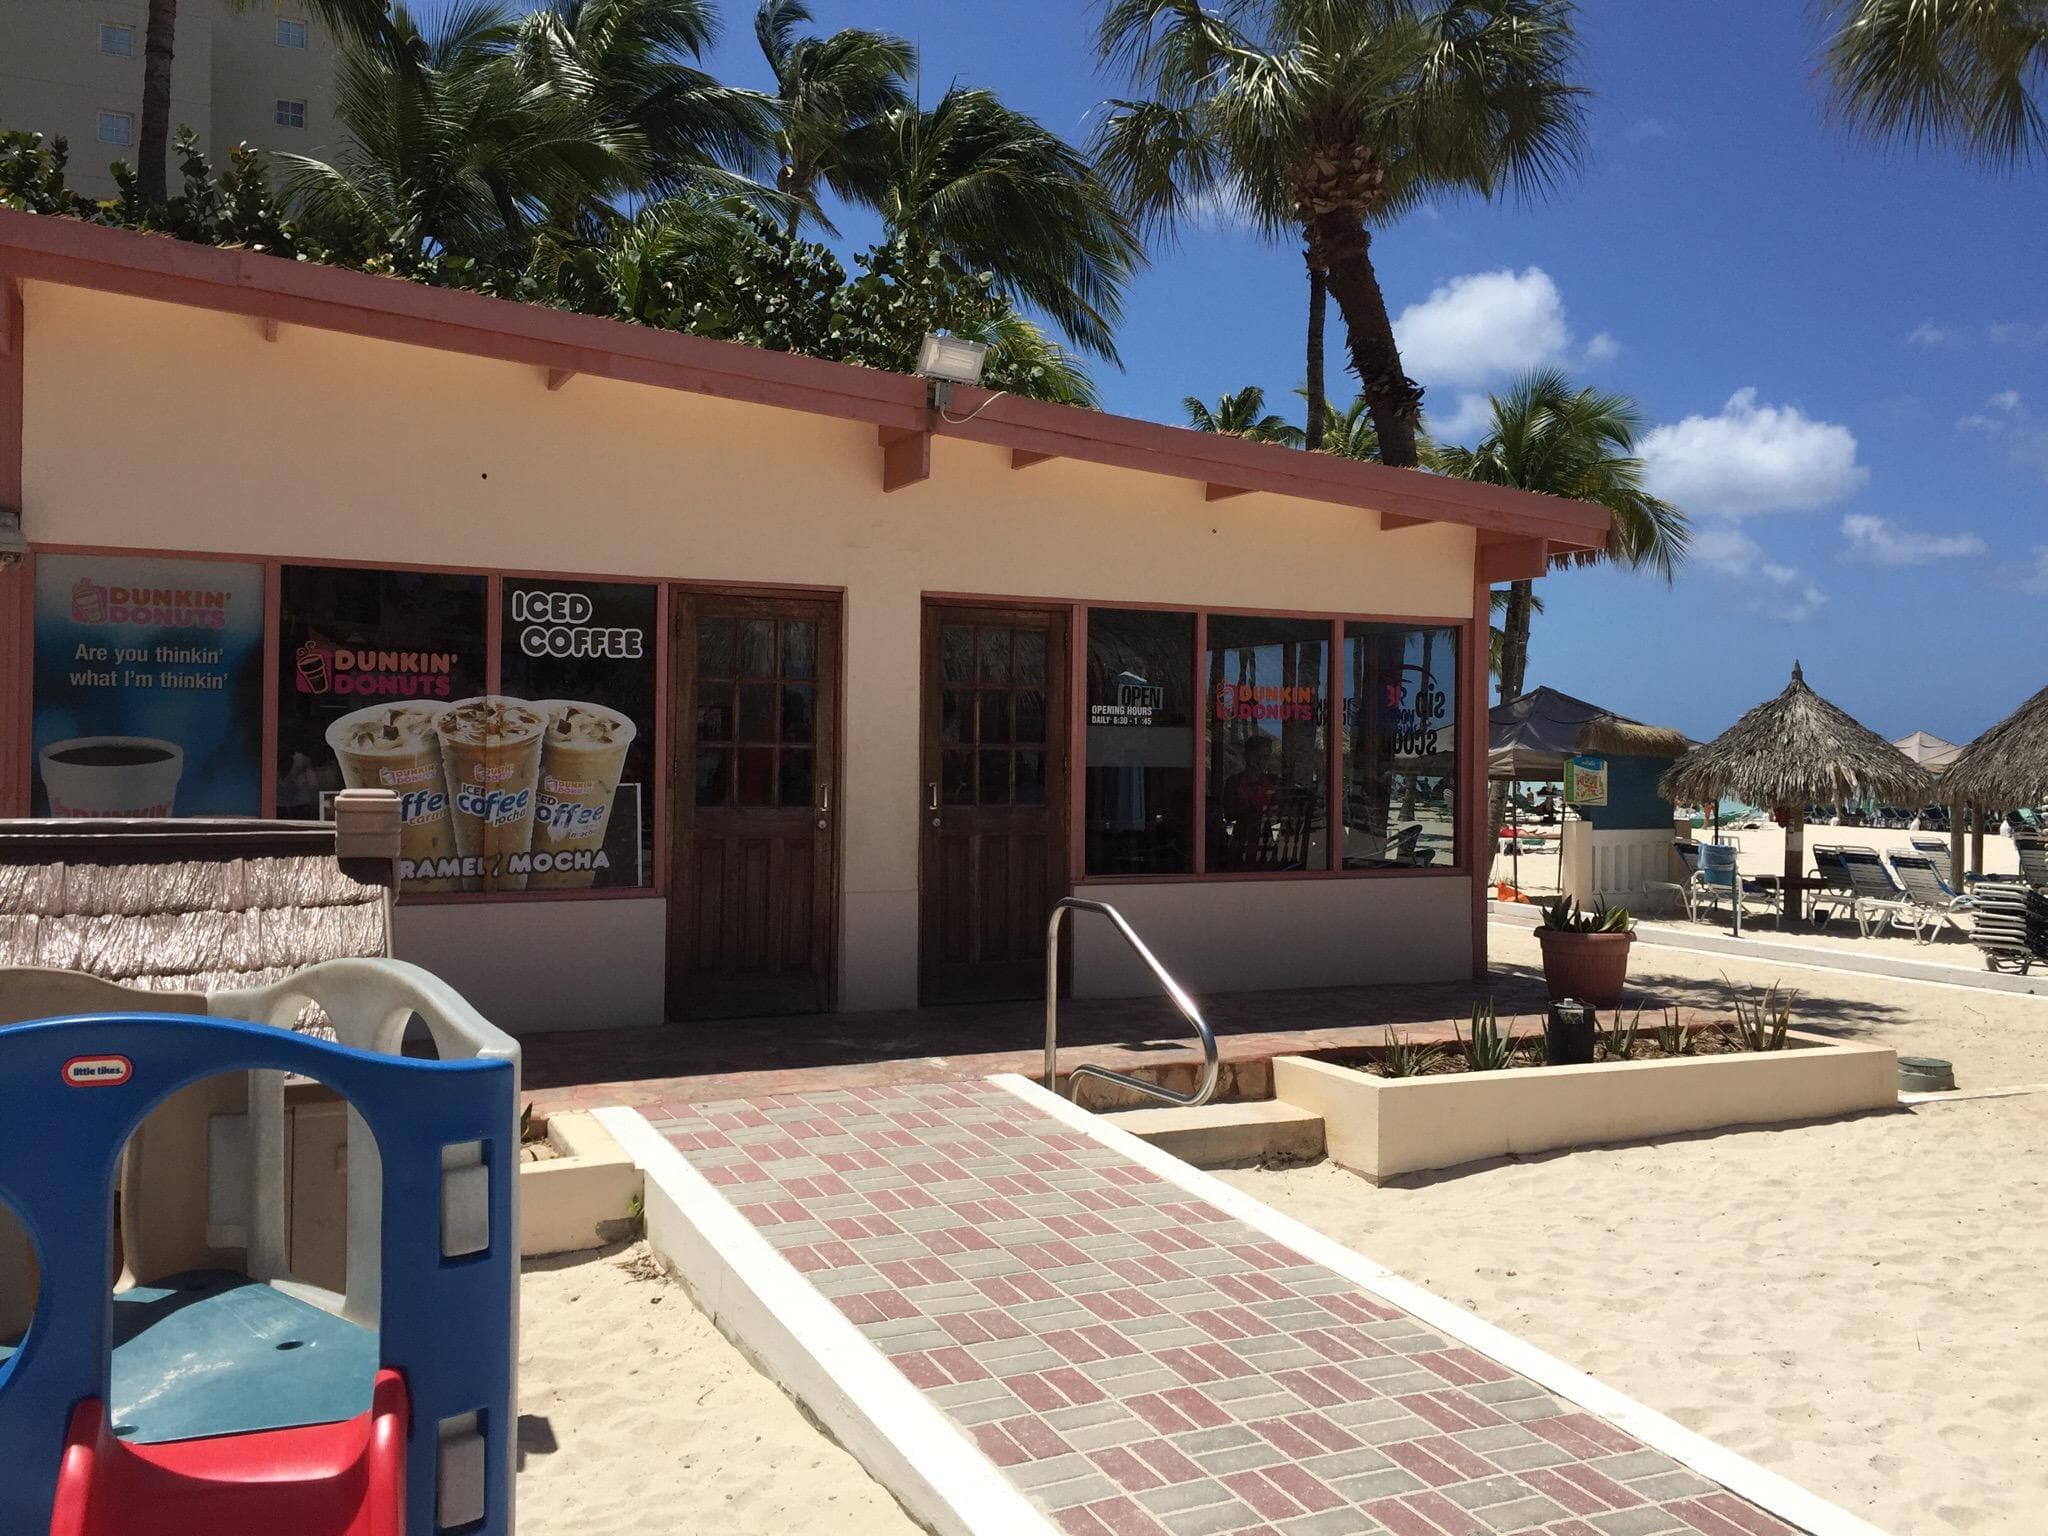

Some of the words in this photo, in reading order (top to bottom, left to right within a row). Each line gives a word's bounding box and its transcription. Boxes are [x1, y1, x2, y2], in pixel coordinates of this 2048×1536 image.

[108, 586, 232, 609] DUNKIN'
[512, 590, 593, 624] ICED
[108, 605, 226, 628] DONUTS
[520, 625, 643, 659] COFFEE
[74, 643, 108, 661] Are
[114, 647, 149, 665] you
[155, 646, 224, 665] thinkin'
[334, 649, 458, 674] DUNKIN'
[69, 670, 117, 687] what
[124, 670, 153, 688] I'm
[160, 671, 229, 690] thinkin'
[334, 673, 450, 696] DONUTS
[1121, 685, 1161, 708] OPEN
[1238, 684, 1316, 703] DUNKIN'
[1091, 704, 1125, 715] OPENING
[1126, 705, 1152, 716] HOURS
[1238, 703, 1312, 720] DONUTS
[536, 803, 606, 829] offee
[401, 857, 486, 879] RAMEL
[508, 849, 610, 875] MOCHA
[73, 1066, 95, 1076] little
